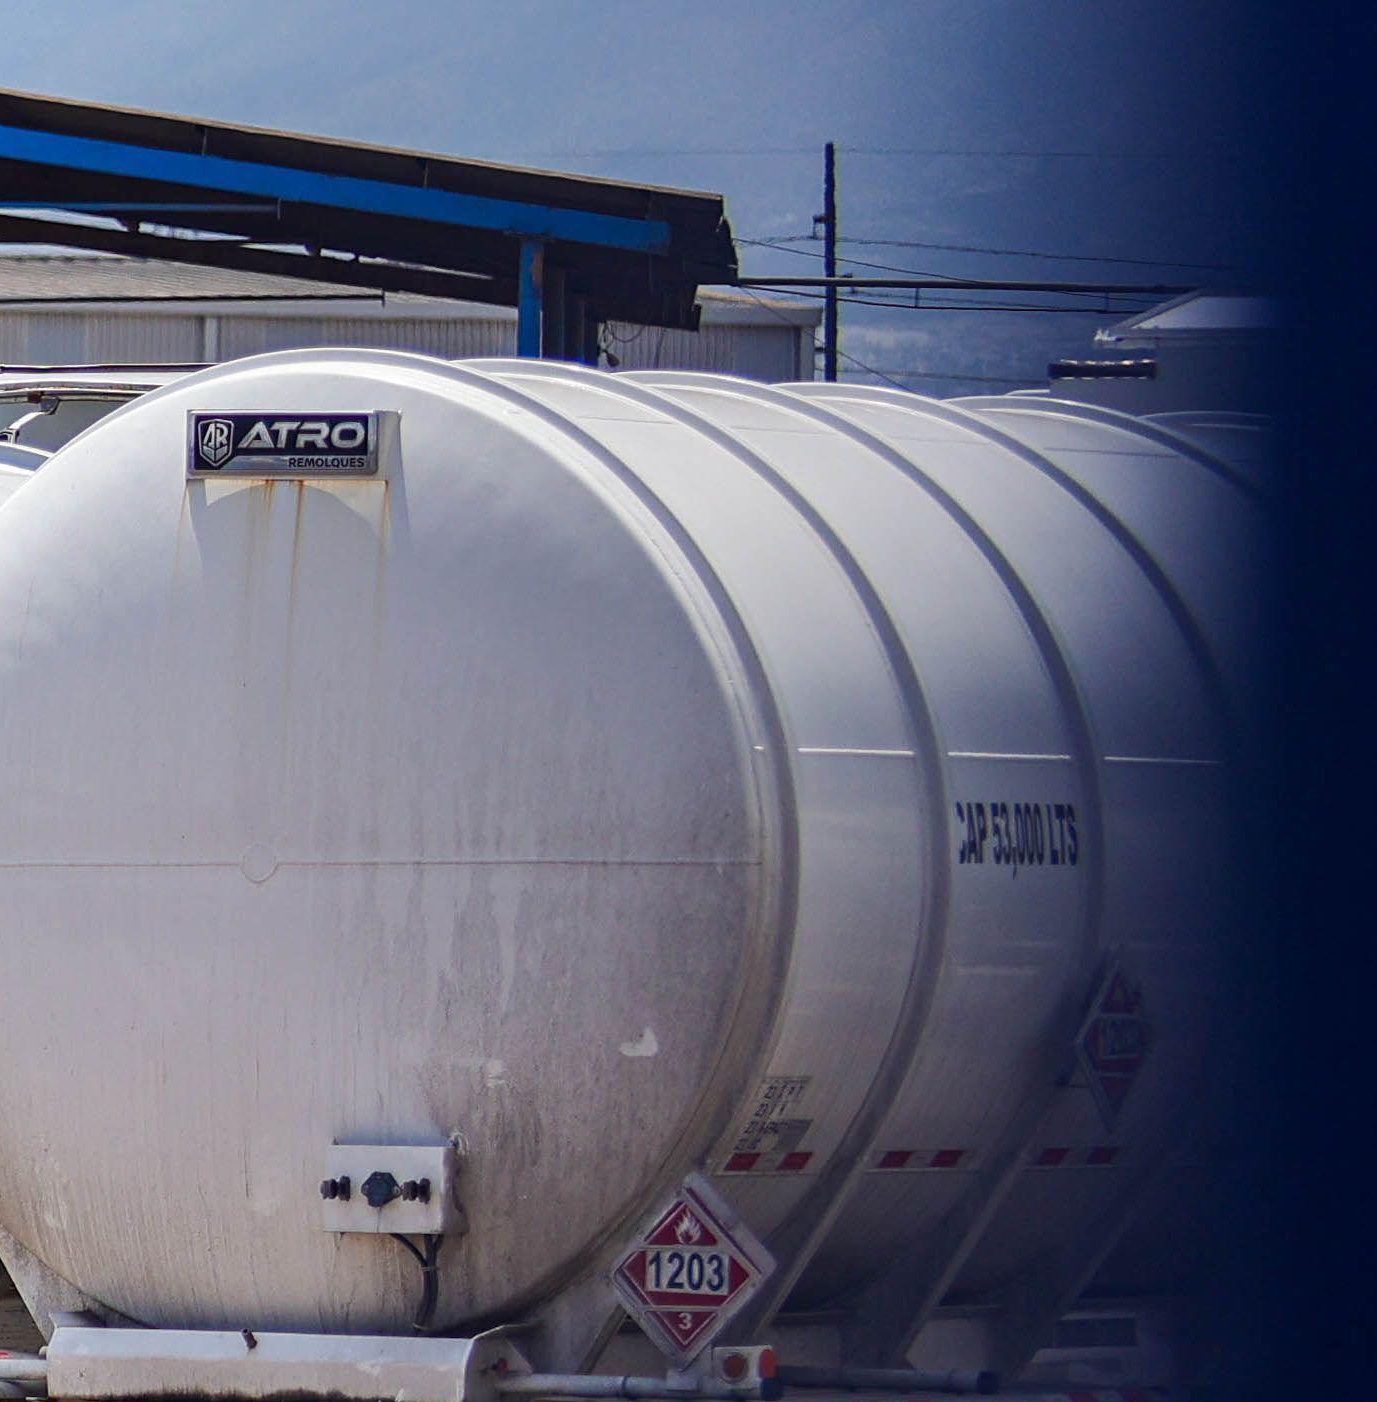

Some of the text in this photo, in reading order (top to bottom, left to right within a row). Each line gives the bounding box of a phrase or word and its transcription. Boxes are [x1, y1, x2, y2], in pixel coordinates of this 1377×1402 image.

[237, 420, 366, 450] ATRO
[288, 457, 365, 469] REMOLQUES
[990, 801, 1045, 880] 53,000
[1045, 803, 1078, 866] LTS
[647, 1251, 725, 1292] 1203
[678, 1311, 693, 1330] 3
